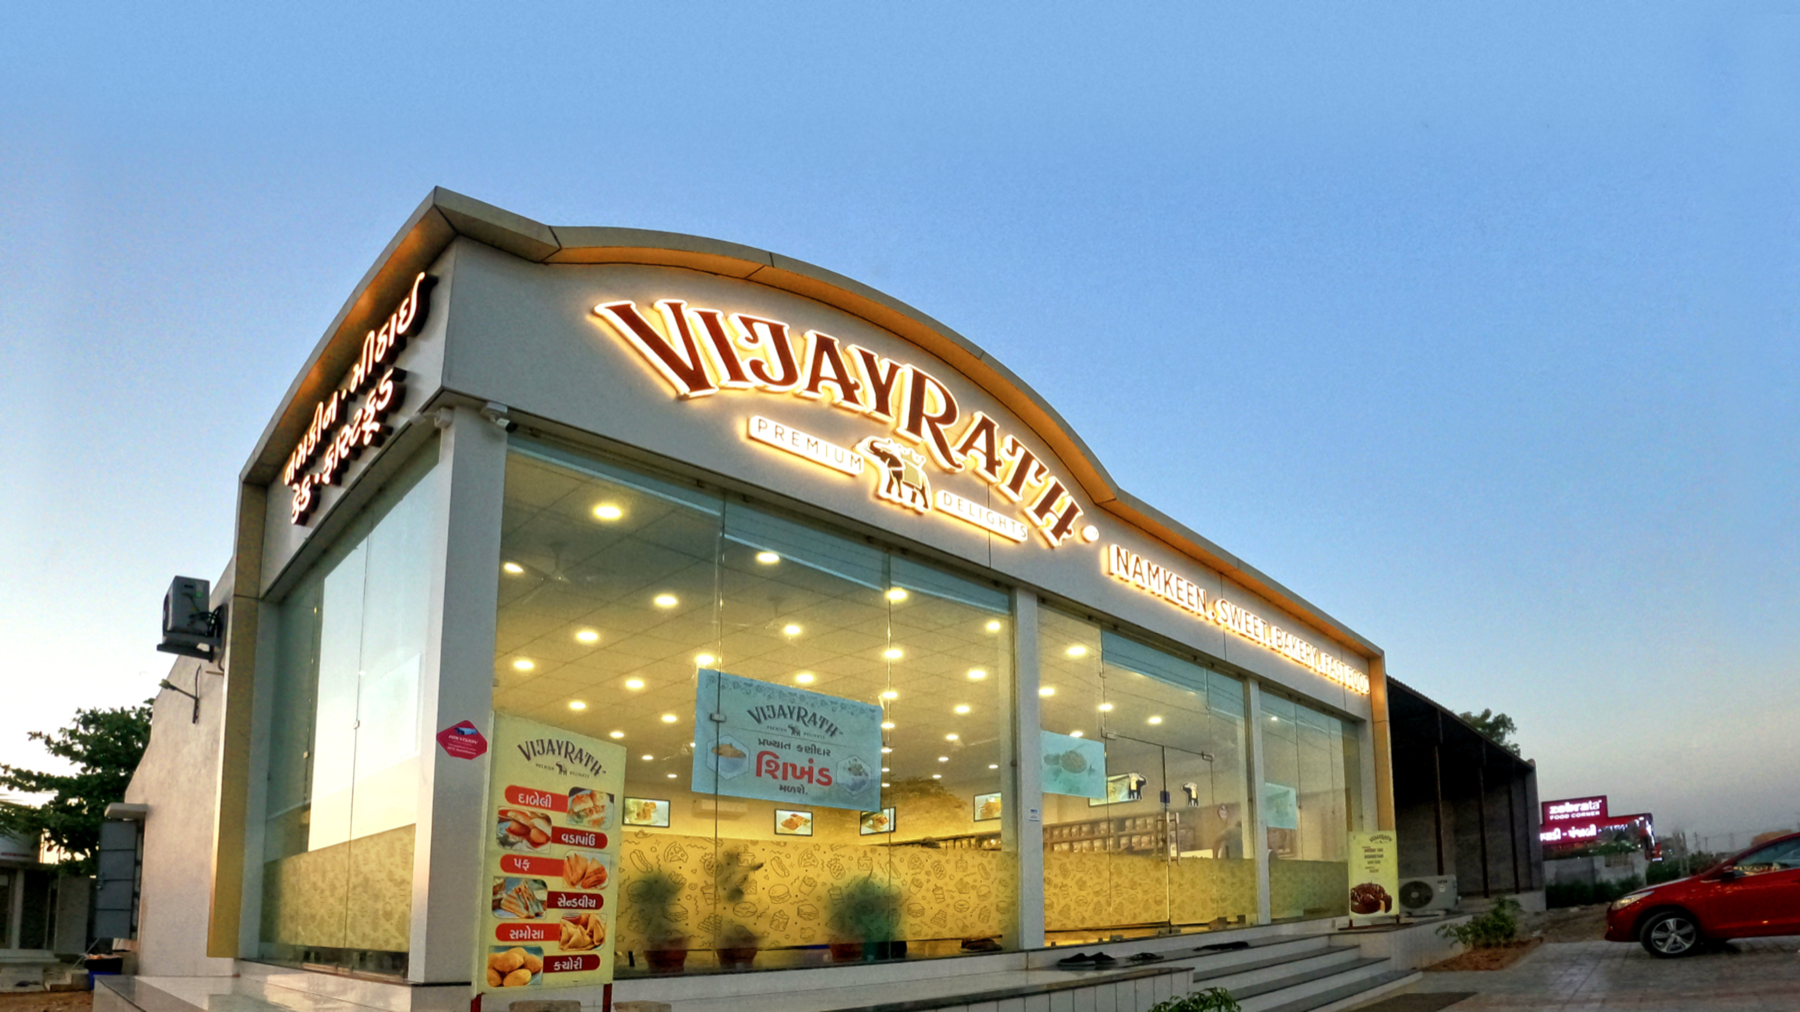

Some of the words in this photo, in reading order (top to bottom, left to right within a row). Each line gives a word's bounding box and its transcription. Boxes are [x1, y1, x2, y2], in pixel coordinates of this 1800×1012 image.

[284, 390, 339, 485] નમકીન
[595, 300, 1084, 547] VIJAYRATH
[756, 417, 863, 472] PREMIUM
[942, 490, 1028, 540] DELIGHTS
[1324, 652, 1346, 682] FAST
[1348, 666, 1370, 694] FOOD
[747, 704, 839, 738] VIJAYRATH
[517, 738, 602, 777] VIJAYRATH
[755, 750, 833, 787] શિખંડ
[518, 792, 552, 809] દાબેલી
[1550, 813, 1570, 821] FOOD
[1571, 810, 1600, 819] CORNER
[513, 857, 531, 871] પફ
[509, 925, 545, 940] સમોસા
[553, 957, 583, 971] કચોરી
